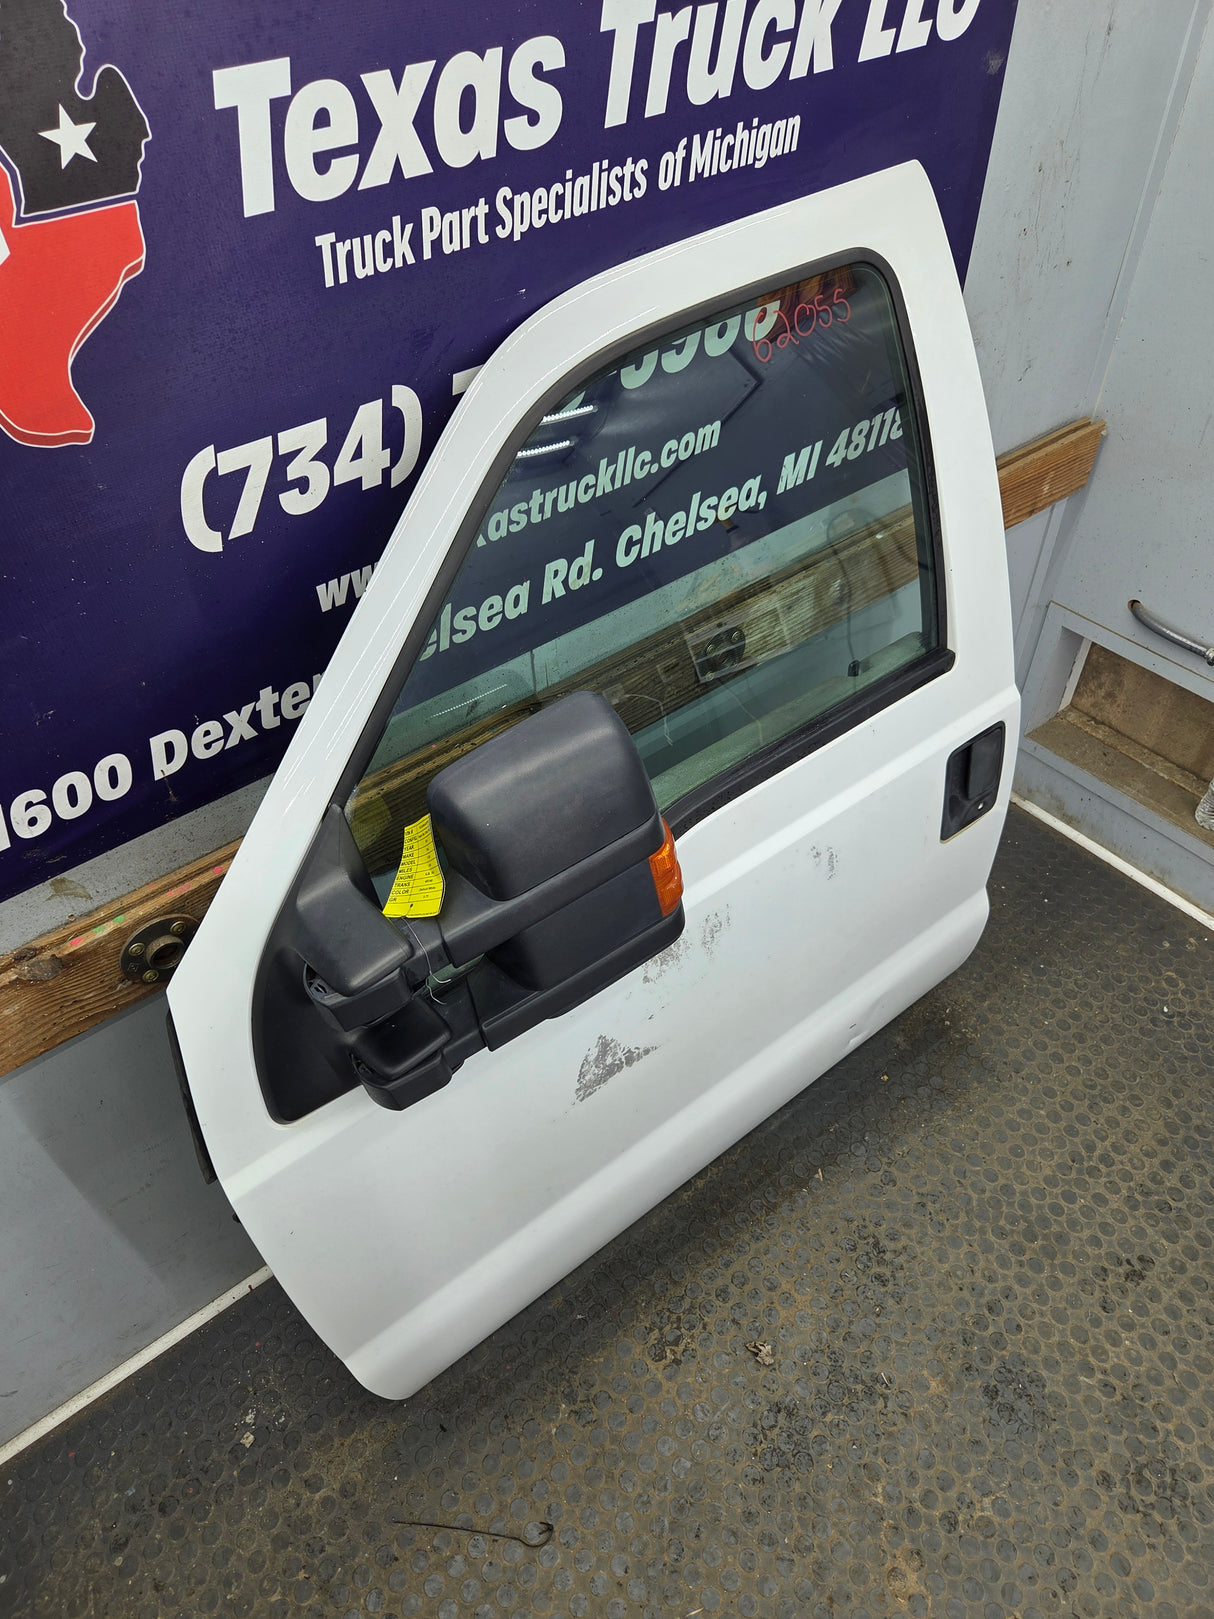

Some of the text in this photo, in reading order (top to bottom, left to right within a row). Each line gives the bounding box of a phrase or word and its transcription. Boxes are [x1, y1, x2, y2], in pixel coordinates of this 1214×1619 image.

[212, 35, 566, 218] Texas
[600, 0, 842, 129] Truck
[315, 114, 801, 288] Truck Part Specialists of Michigan
[752, 287, 852, 364] 62055
[180, 384, 424, 553] (734)
[315, 419, 722, 613] ww astruckllc.com
[541, 541, 603, 605] Rd.
[615, 473, 768, 569] Chelsea,
[776, 440, 824, 496] MI
